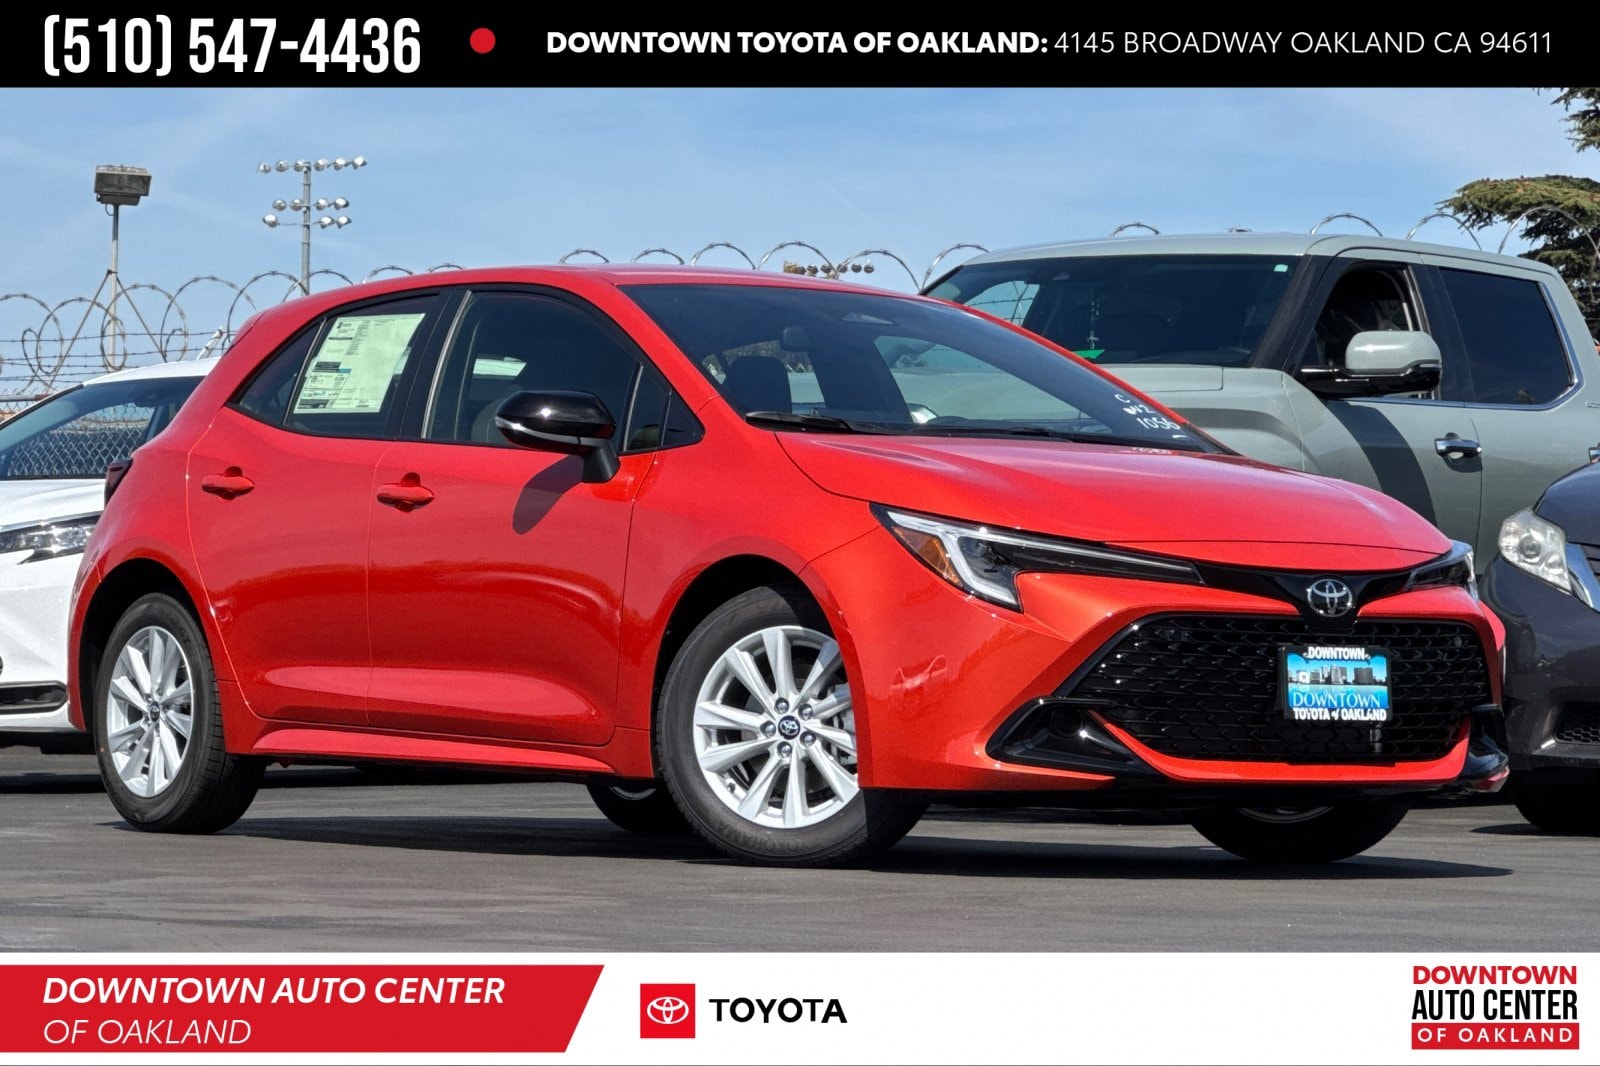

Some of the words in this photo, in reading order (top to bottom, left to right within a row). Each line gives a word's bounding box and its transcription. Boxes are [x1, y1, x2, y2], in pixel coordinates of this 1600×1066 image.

[1307, 646, 1365, 660] DOWNTOWN
[1293, 692, 1380, 707] DOWNTOWN
[1293, 708, 1330, 720] TOYOTA
[1341, 708, 1387, 721] OAKLAND
